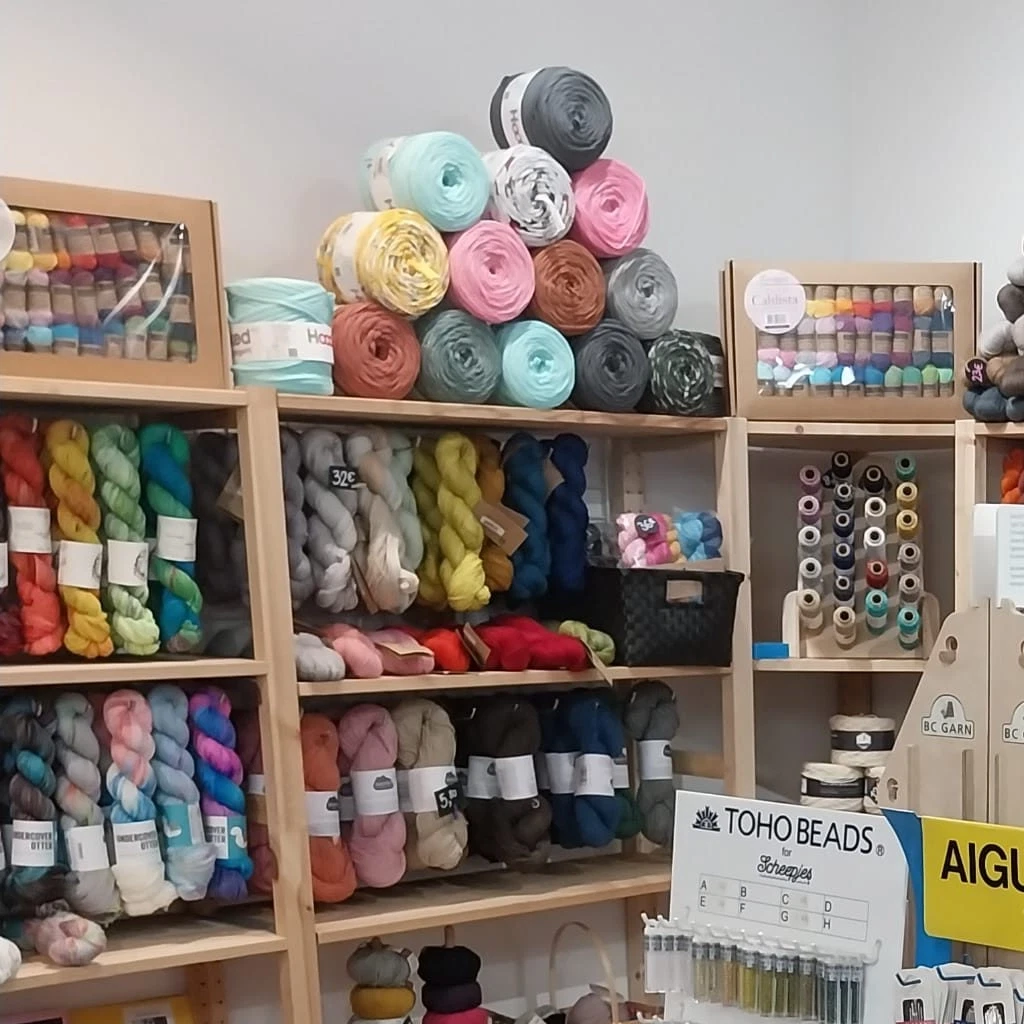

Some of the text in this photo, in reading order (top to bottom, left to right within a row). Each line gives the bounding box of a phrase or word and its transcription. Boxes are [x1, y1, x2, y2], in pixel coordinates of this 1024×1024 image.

[332, 469, 356, 487] 32€
[923, 720, 973, 736] BC GARN
[1004, 727, 1019, 740] BC
[725, 807, 874, 855] TOHO BEADS
[781, 846, 793, 857] for
[757, 854, 813, 884] Scheepjes
[700, 880, 832, 913] A B C D
[700, 896, 831, 930] E F G H
